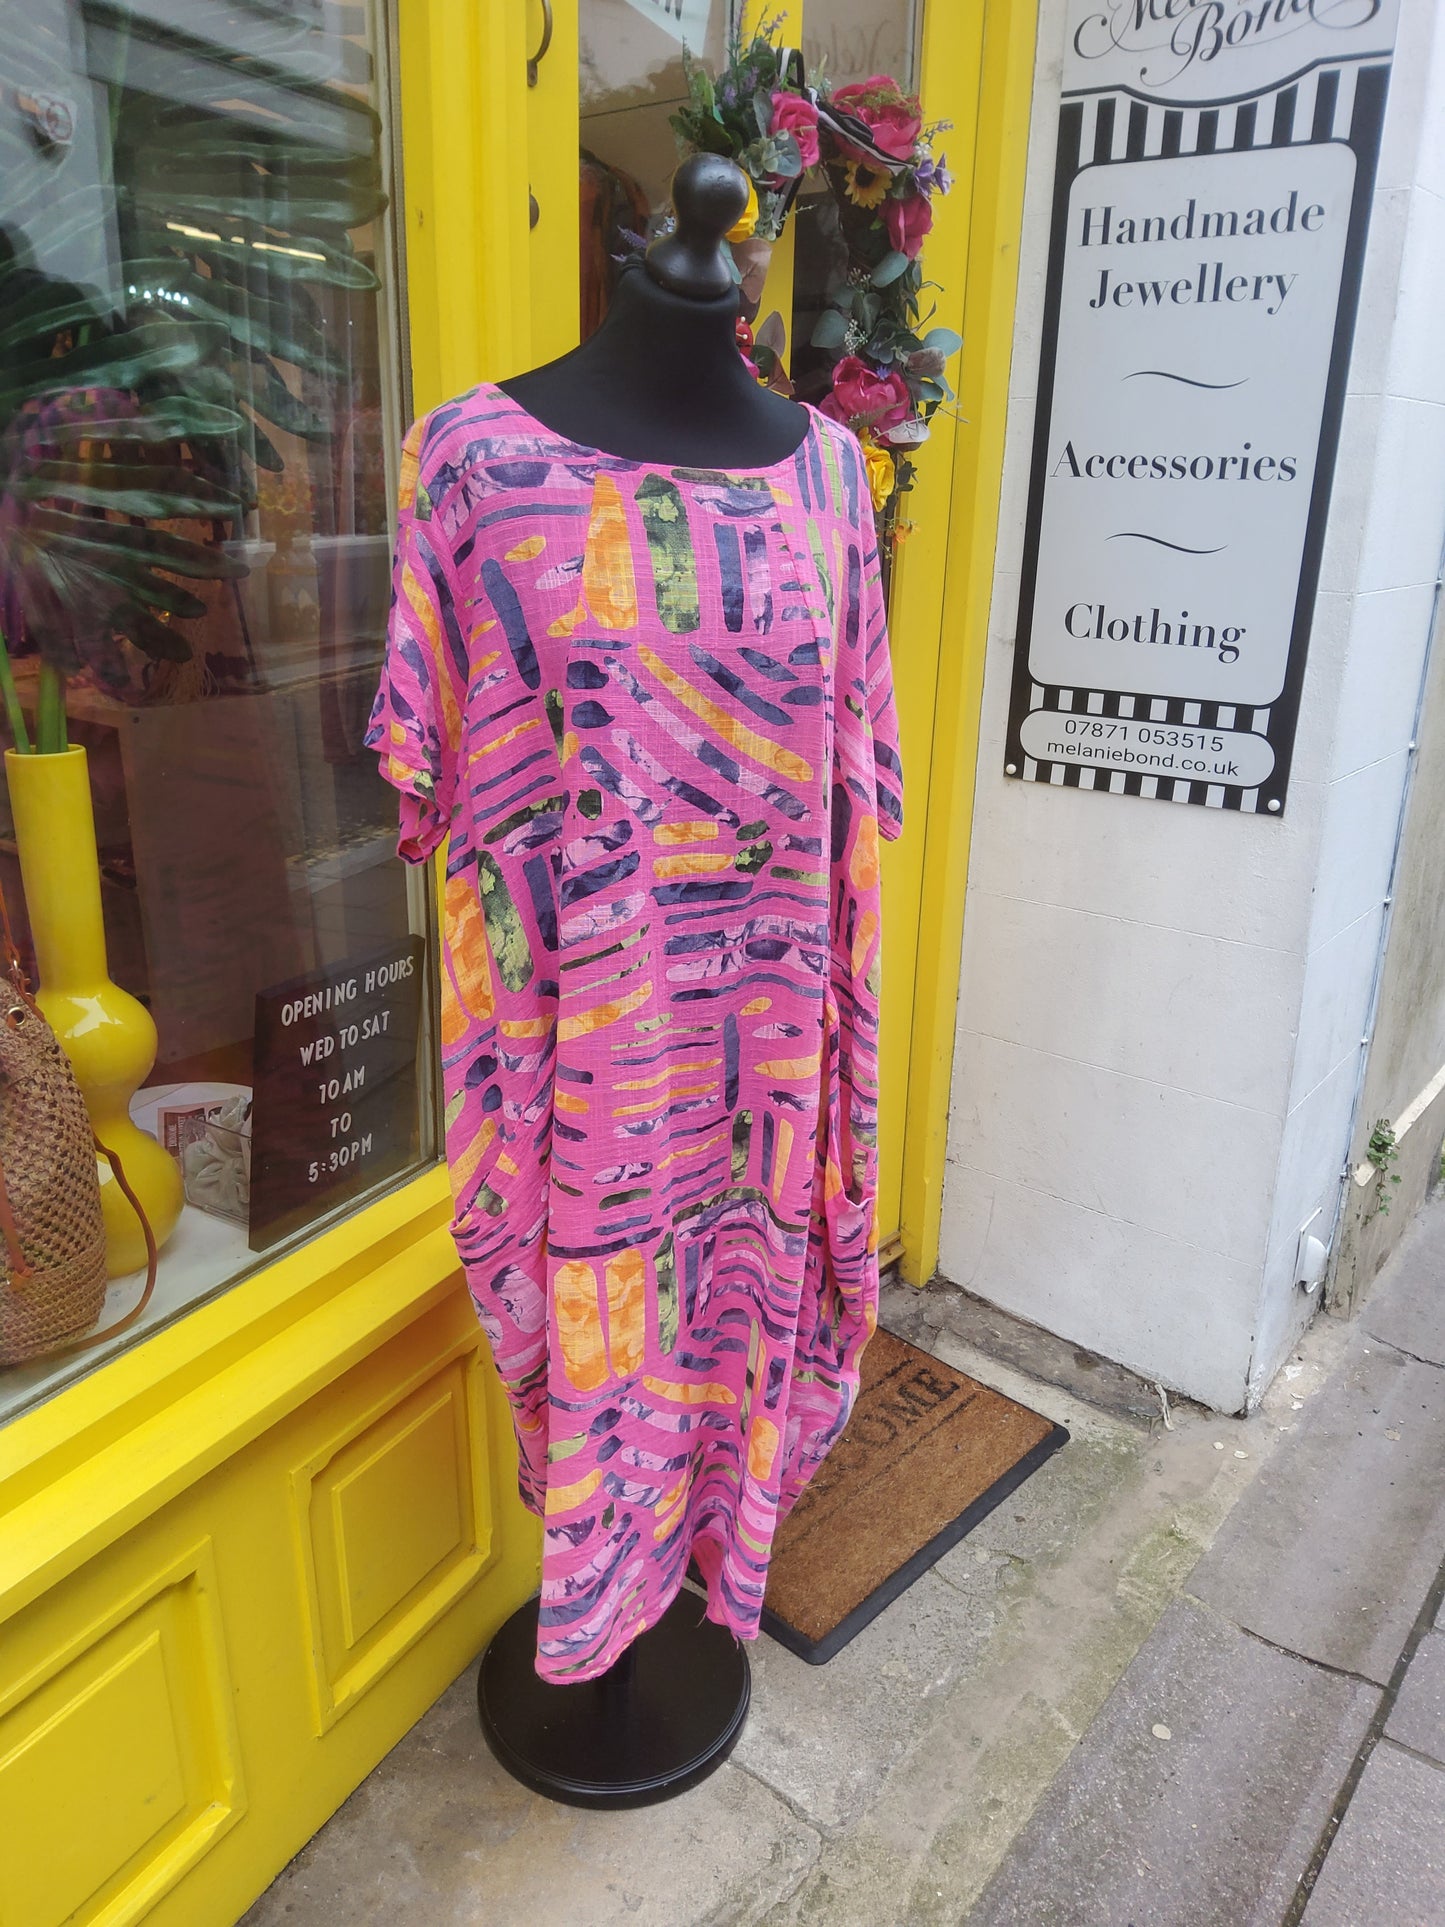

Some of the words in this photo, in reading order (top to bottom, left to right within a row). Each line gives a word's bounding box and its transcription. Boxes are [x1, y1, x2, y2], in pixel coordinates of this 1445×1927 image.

[1077, 190, 1325, 247] Handmade
[1089, 262, 1299, 315] Jewellery
[1050, 440, 1297, 482] Accessories
[1064, 602, 1247, 664] Clothing
[1047, 740, 1239, 777] melaniebond.co.uk
[1065, 719, 1128, 741] 07871
[1138, 728, 1224, 752] 053515
[281, 979, 357, 1027] OPENING
[364, 956, 414, 994] HOURS
[300, 1036, 334, 1067] WED
[339, 1024, 358, 1050] TO
[361, 1011, 390, 1040] SAT
[330, 1112, 352, 1138] TO
[308, 1133, 372, 1183] 5:30PM
